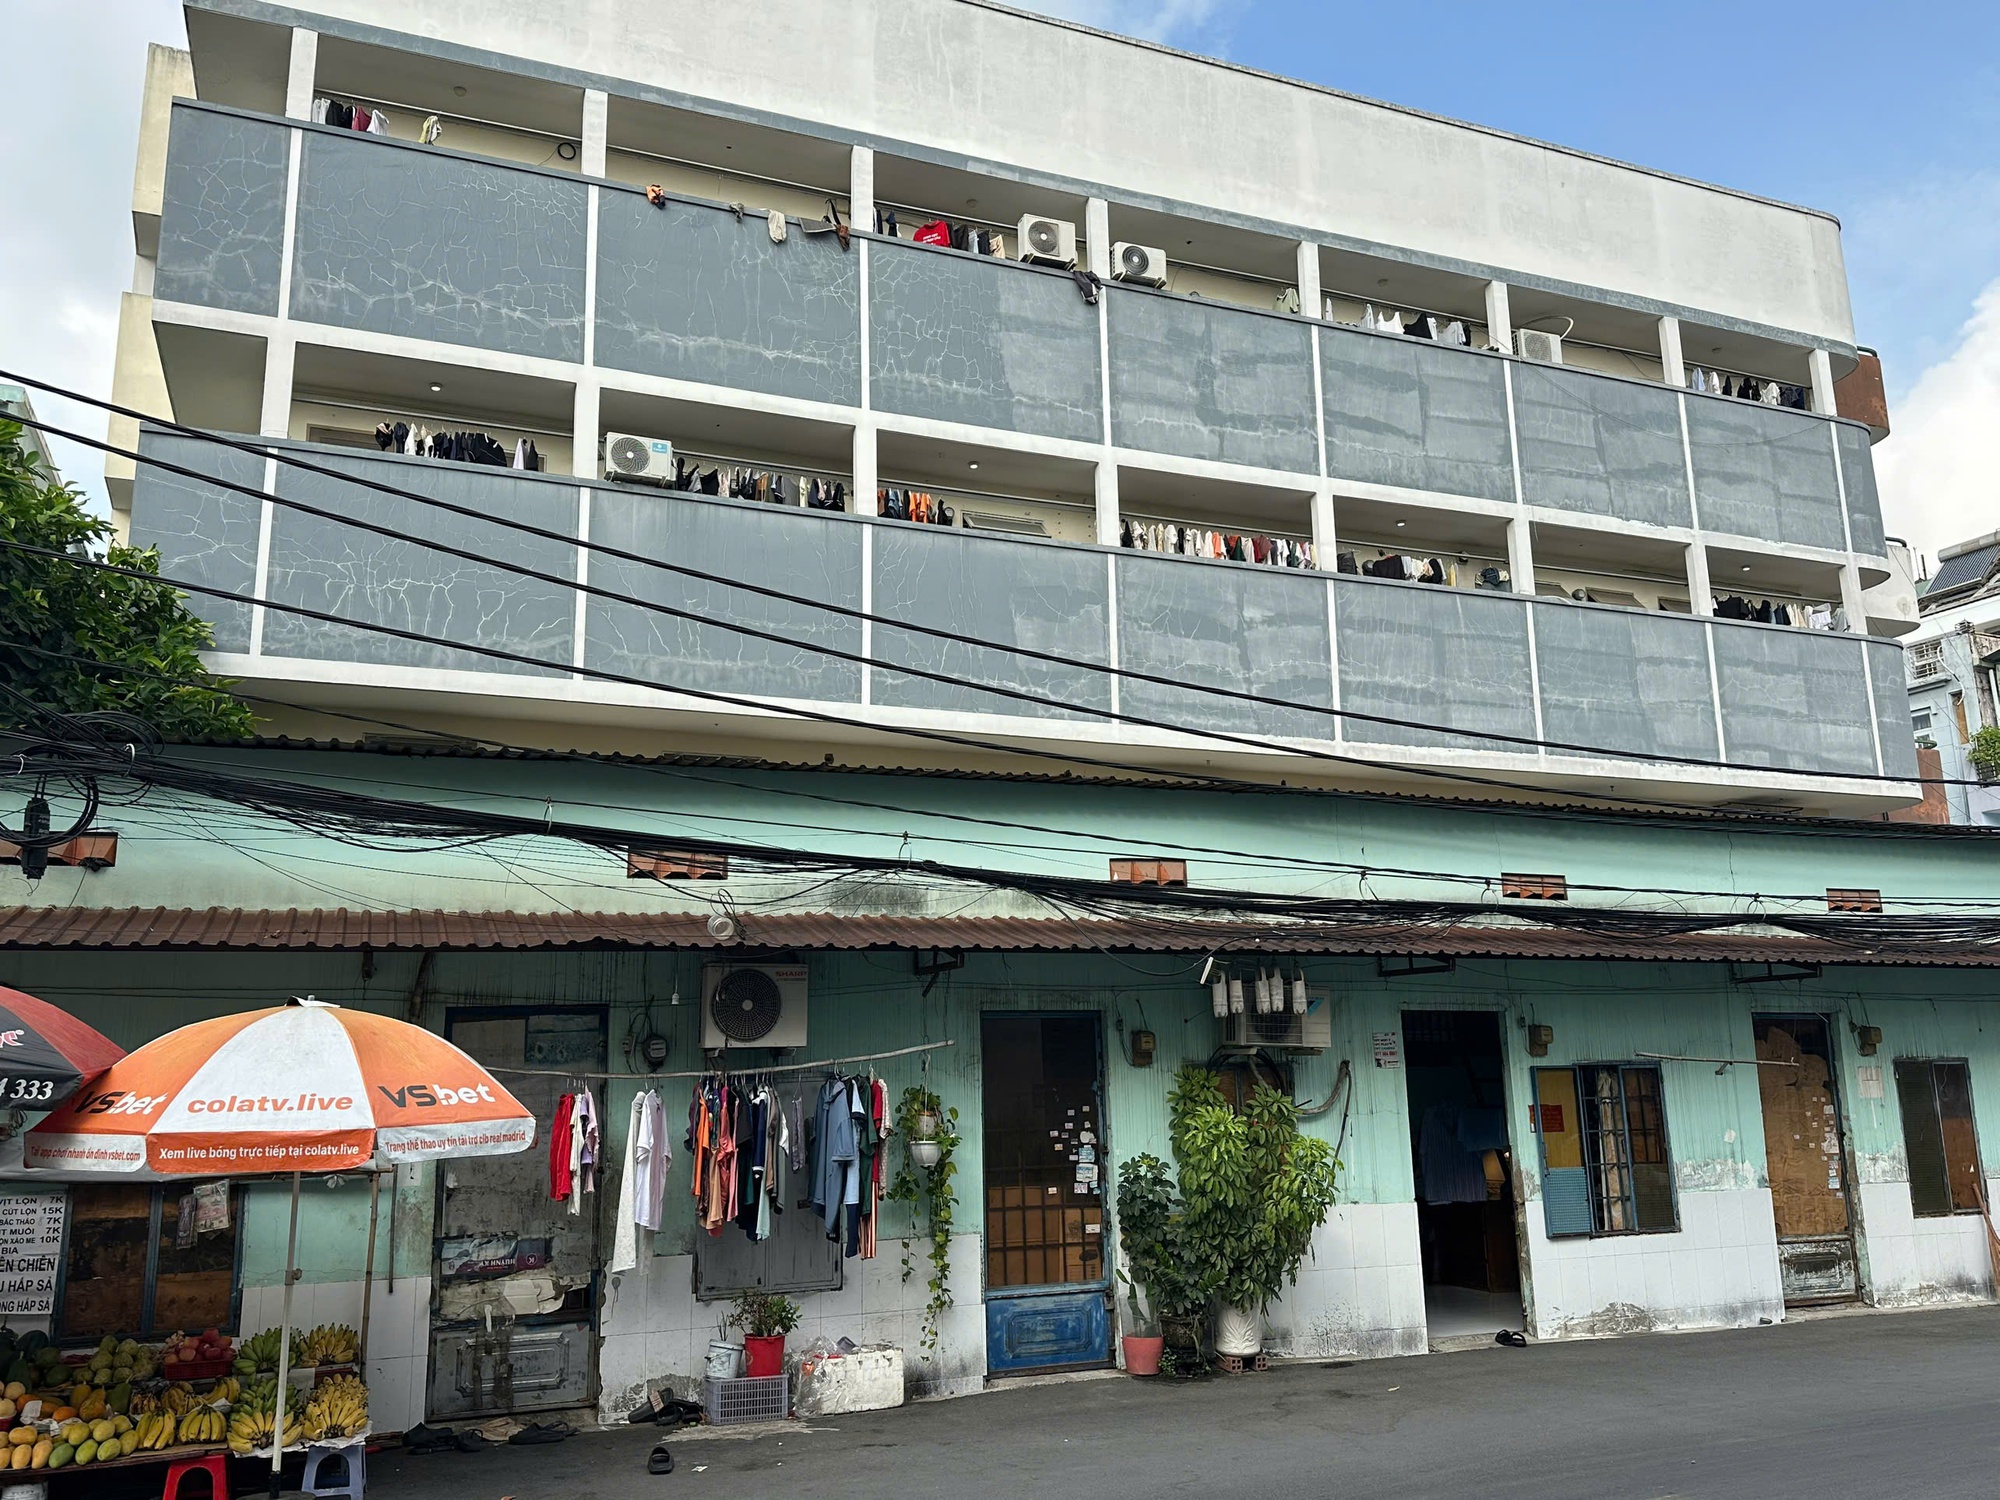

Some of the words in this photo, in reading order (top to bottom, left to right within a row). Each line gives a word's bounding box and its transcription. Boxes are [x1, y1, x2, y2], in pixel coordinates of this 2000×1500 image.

[10, 1079, 54, 1100] 333
[187, 1093, 353, 1113] colatv.live
[385, 1142, 406, 1154] Trang
[420, 1139, 436, 1150] thao
[438, 1140, 446, 1150] uy
[479, 1133, 489, 1144] clb
[490, 1132, 502, 1143] real
[502, 1130, 526, 1142] madrid
[68, 1148, 86, 1159] nhanh
[108, 1150, 140, 1161] vsbet.com
[159, 1148, 184, 1159] Xem
[187, 1146, 207, 1158] live
[209, 1146, 236, 1160] bóng
[239, 1146, 263, 1159] trực
[265, 1144, 286, 1158] tiếp
[288, 1144, 302, 1158] tại
[304, 1144, 359, 1155] colatv.live
[18, 1255, 56, 1272] CHIÊN
[0, 1301, 14, 1312] NG
